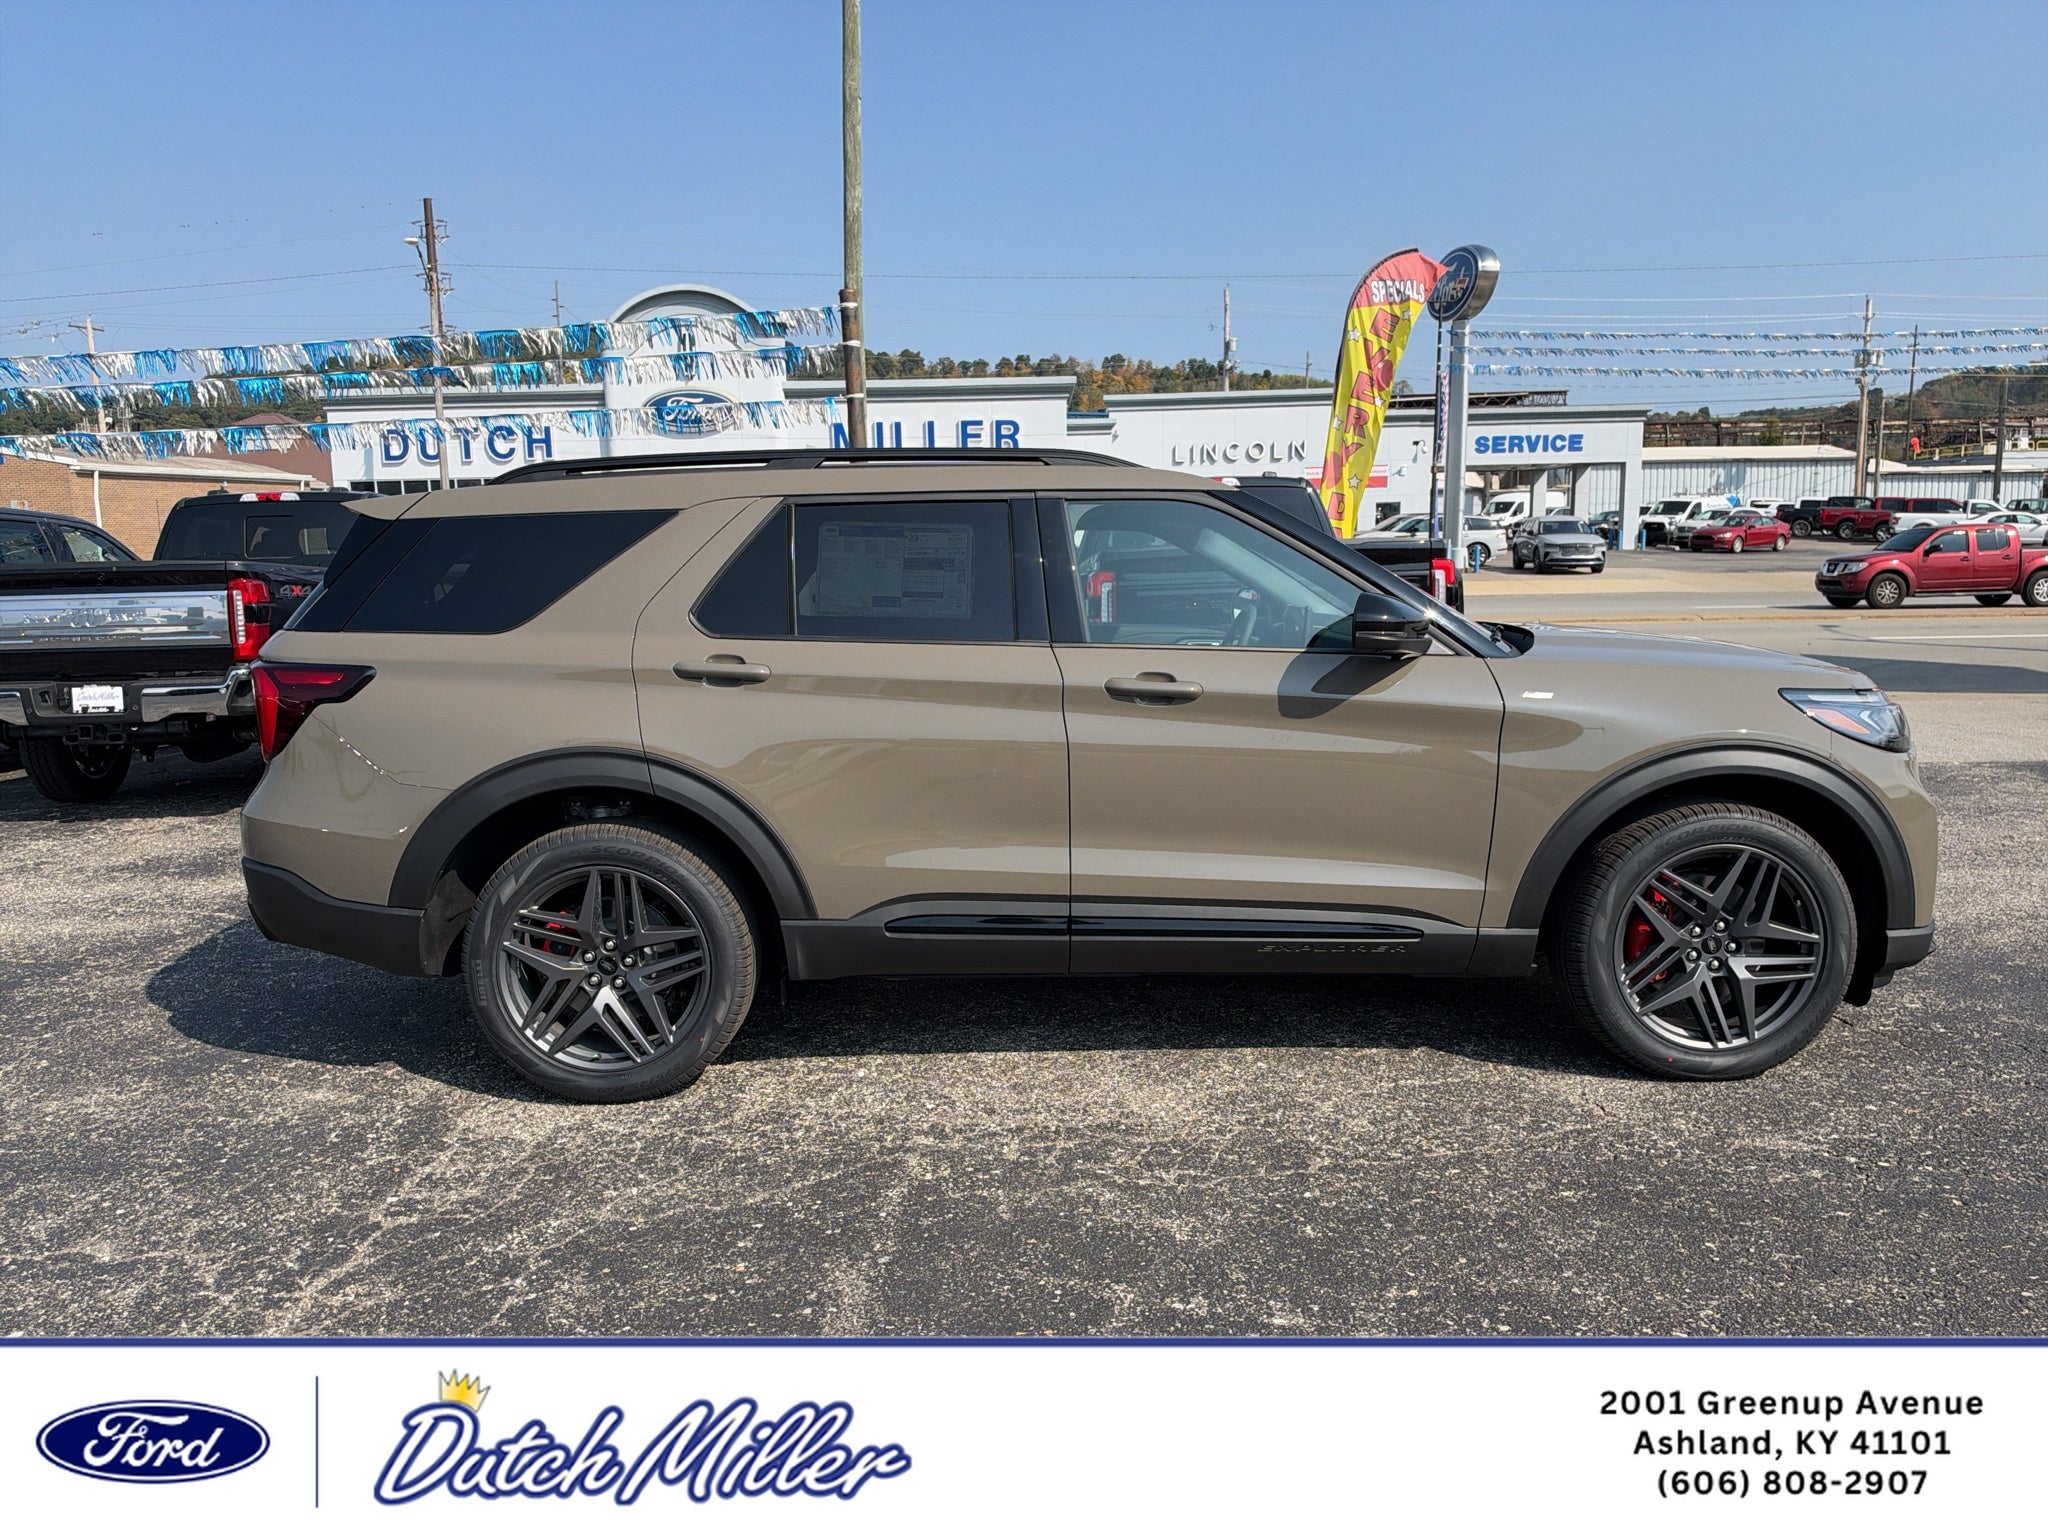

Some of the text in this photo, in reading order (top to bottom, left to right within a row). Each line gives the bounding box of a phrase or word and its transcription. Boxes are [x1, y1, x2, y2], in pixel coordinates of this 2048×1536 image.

[1370, 279, 1426, 304] SPECIALS
[382, 425, 554, 463] DUTCH
[1172, 439, 1308, 466] LINCOLN
[1474, 433, 1584, 455] SERVICE
[1256, 943, 1408, 953] EXPLORER
